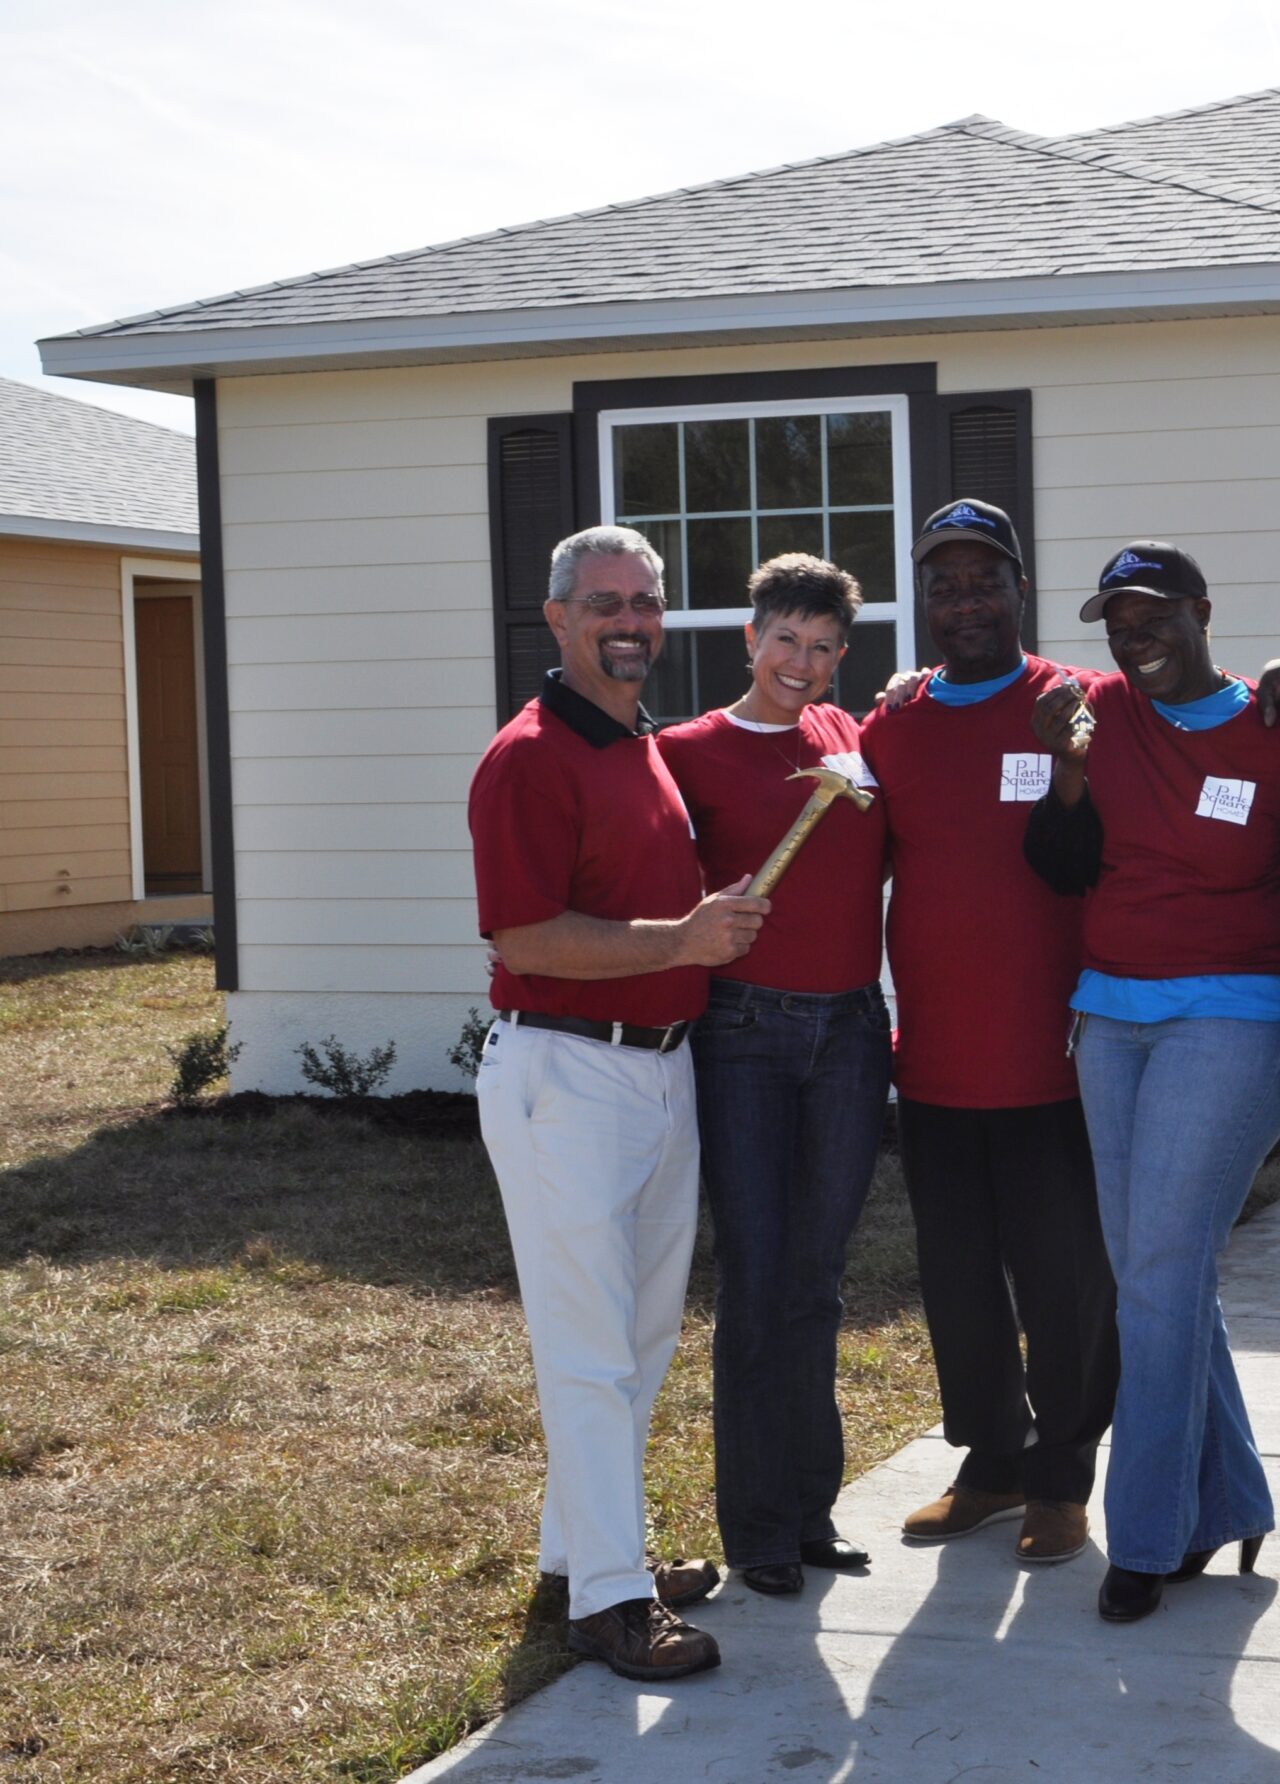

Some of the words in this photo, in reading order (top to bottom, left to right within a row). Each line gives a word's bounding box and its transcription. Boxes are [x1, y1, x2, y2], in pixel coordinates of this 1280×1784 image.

[1016, 755, 1046, 778] Park
[1000, 769, 1051, 800] Square
[1216, 781, 1248, 804] Park
